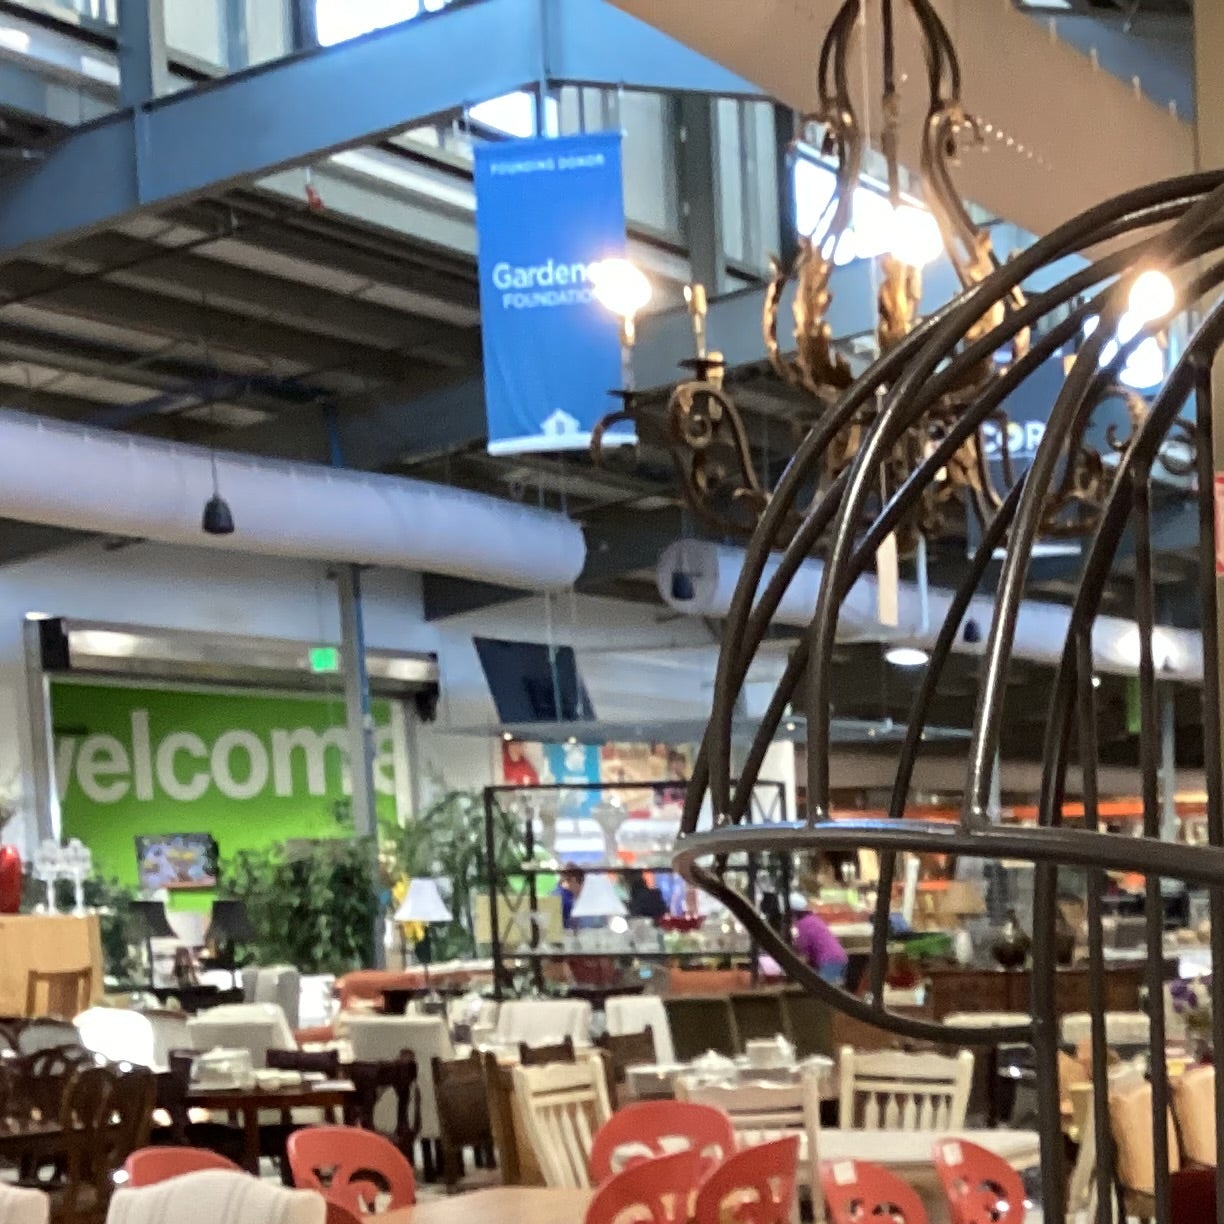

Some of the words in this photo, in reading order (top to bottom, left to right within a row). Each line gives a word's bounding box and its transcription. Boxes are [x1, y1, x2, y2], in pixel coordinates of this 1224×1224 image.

[492, 258, 592, 290] Garden
[503, 288, 598, 309] FOUNDATIO
[54, 710, 395, 803] elcom
